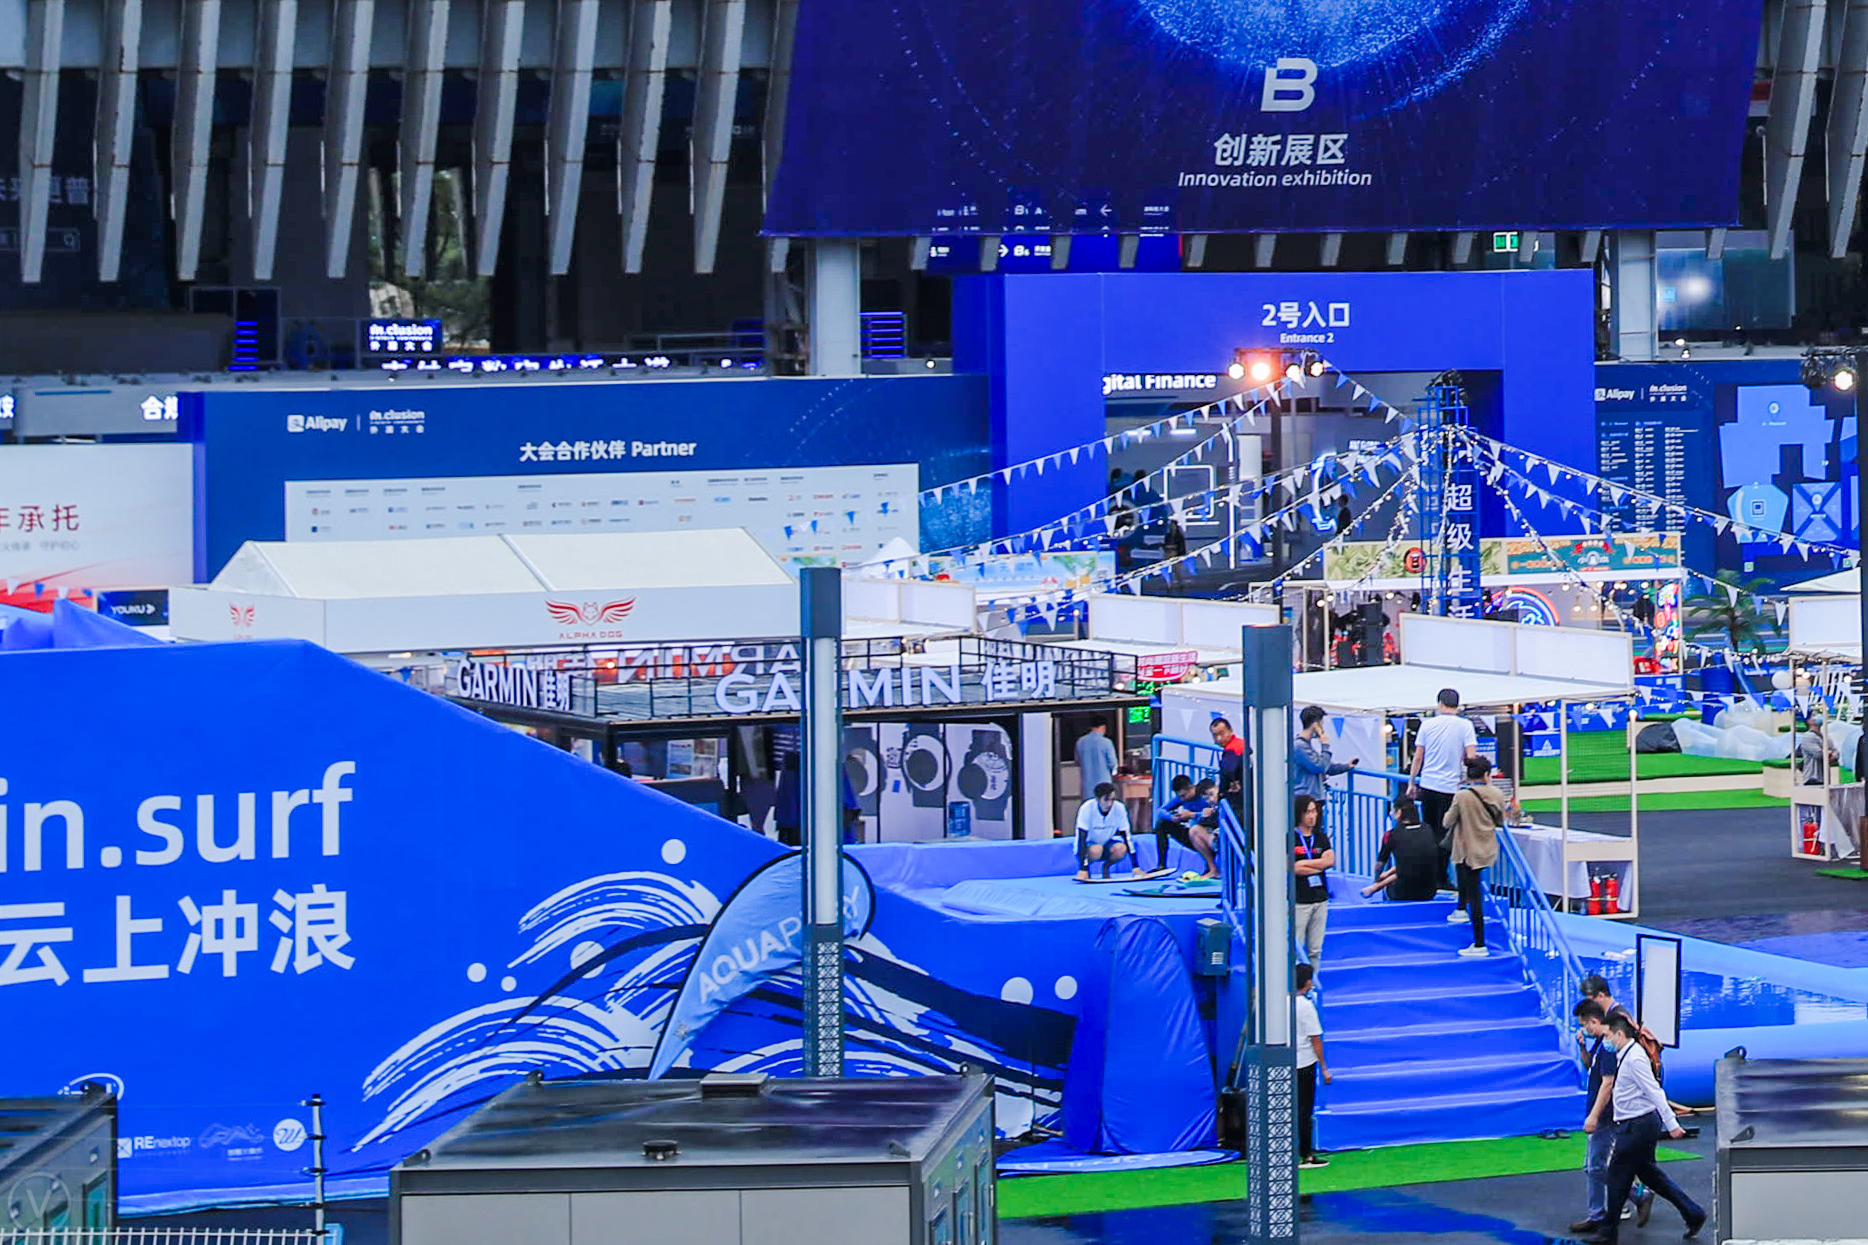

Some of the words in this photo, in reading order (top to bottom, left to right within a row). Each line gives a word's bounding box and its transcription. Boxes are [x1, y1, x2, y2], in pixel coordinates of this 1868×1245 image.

[1259, 57, 1318, 112] B
[1212, 133, 1348, 168] 创新展区
[1177, 169, 1276, 188] Innovation
[1280, 169, 1372, 188] exhibition
[1261, 302, 1351, 328] 2号入口
[1280, 332, 1323, 344] Entrance
[1326, 332, 1335, 344] 2
[1145, 373, 1217, 390] Finance
[1606, 388, 1635, 401] Alipay
[305, 414, 348, 433] Alipay
[519, 439, 626, 462] 大会合作伙伴
[631, 439, 697, 459] Partner
[111, 605, 146, 615] YOUKU
[458, 659, 537, 709] GARMIN
[715, 664, 961, 715] GAMIN
[981, 660, 1057, 702] 佳明
[0, 883, 356, 987] 云上冲浪
